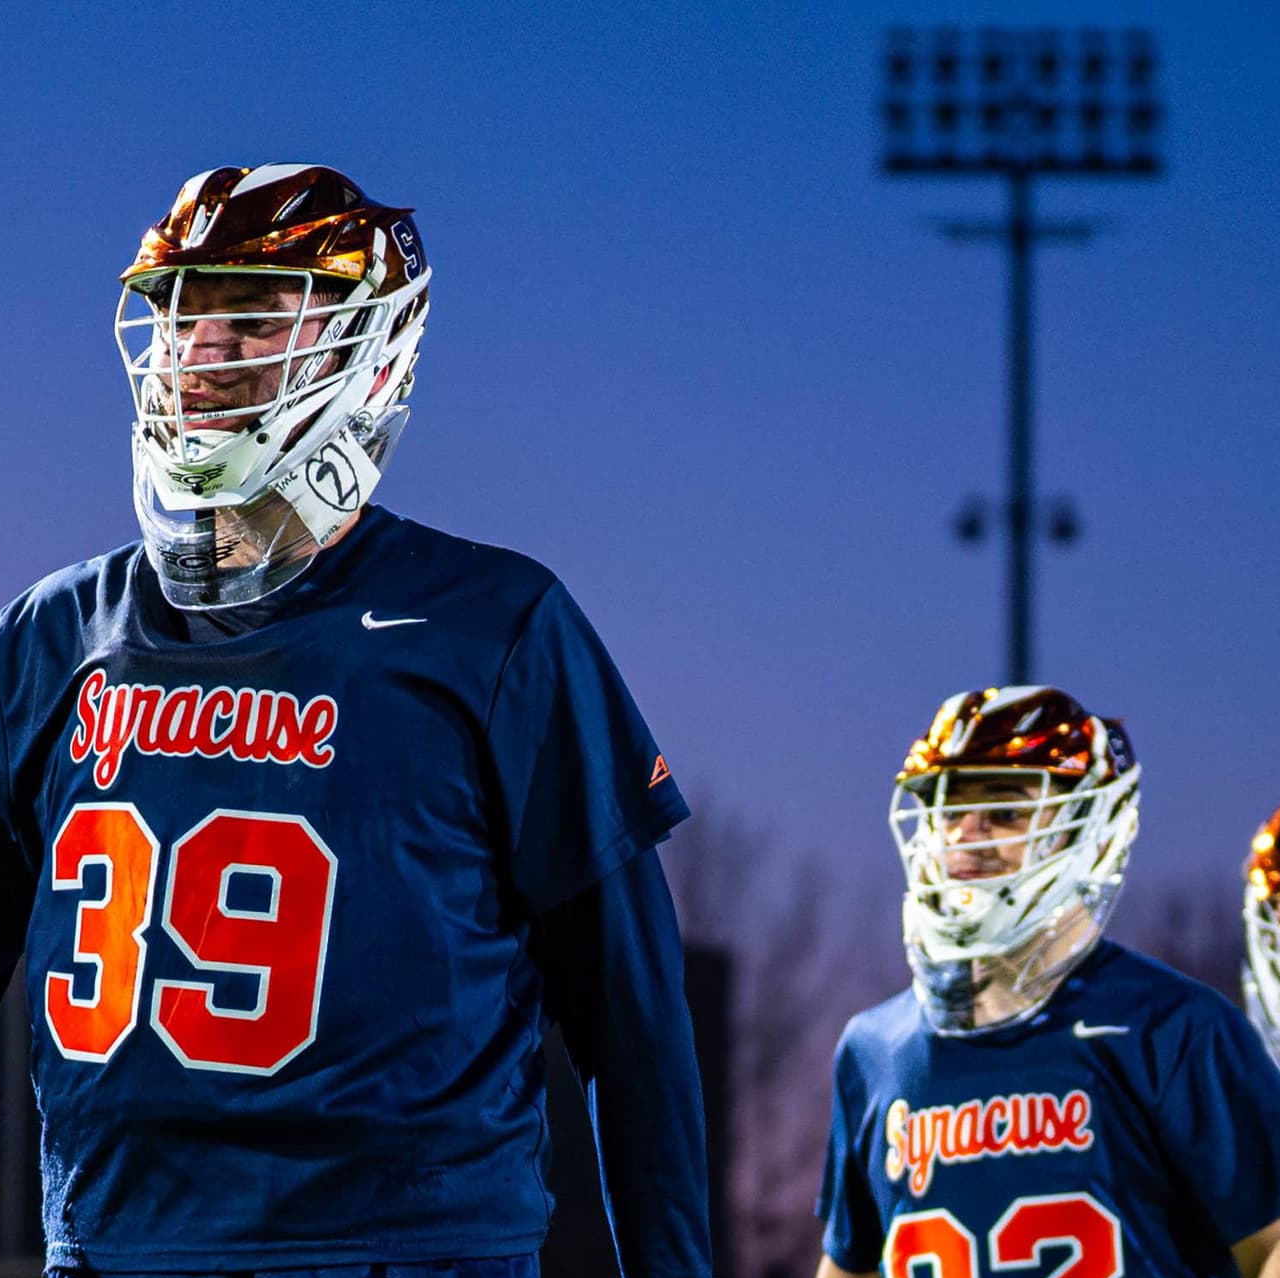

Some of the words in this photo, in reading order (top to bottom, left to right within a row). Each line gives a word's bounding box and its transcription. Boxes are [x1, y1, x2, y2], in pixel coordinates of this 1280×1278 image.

[316, 461, 358, 506] 2
[70, 668, 338, 790] Syracuse
[45, 801, 339, 1077] 39
[884, 1089, 1095, 1198] Syracuse
